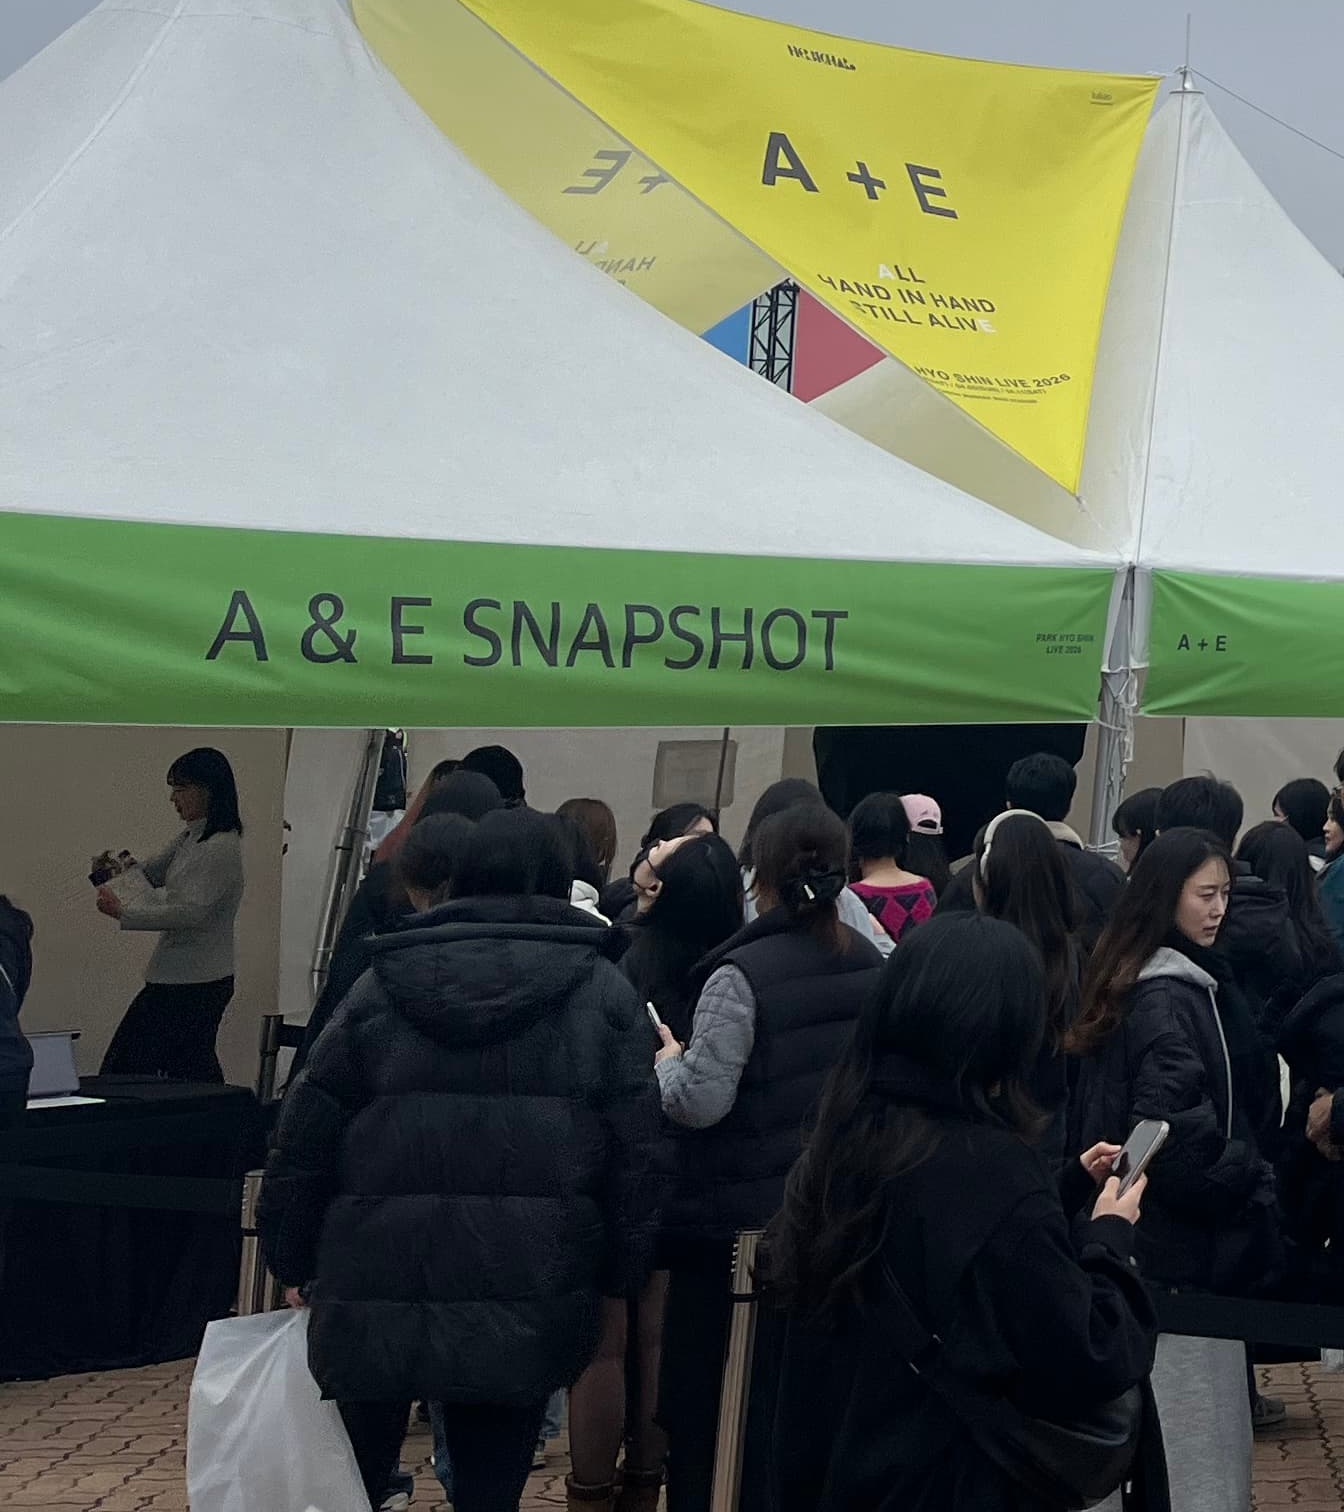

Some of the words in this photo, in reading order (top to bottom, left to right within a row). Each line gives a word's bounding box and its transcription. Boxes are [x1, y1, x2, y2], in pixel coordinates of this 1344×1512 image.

[762, 131, 819, 192] A
[846, 160, 887, 200] +
[904, 162, 959, 219] E
[878, 263, 926, 284] ALL
[897, 288, 926, 306] IN
[929, 292, 996, 313] HAND
[928, 313, 997, 335] ALIVE
[953, 372, 994, 387] SHIN
[994, 377, 1029, 389] LIVE
[1033, 372, 1071, 388] 2026
[205, 590, 269, 662] A
[300, 592, 358, 664] &
[391, 596, 433, 665] E
[463, 598, 849, 671] SNAPSHOT
[1177, 634, 1190, 650] A
[1216, 635, 1228, 651] E
